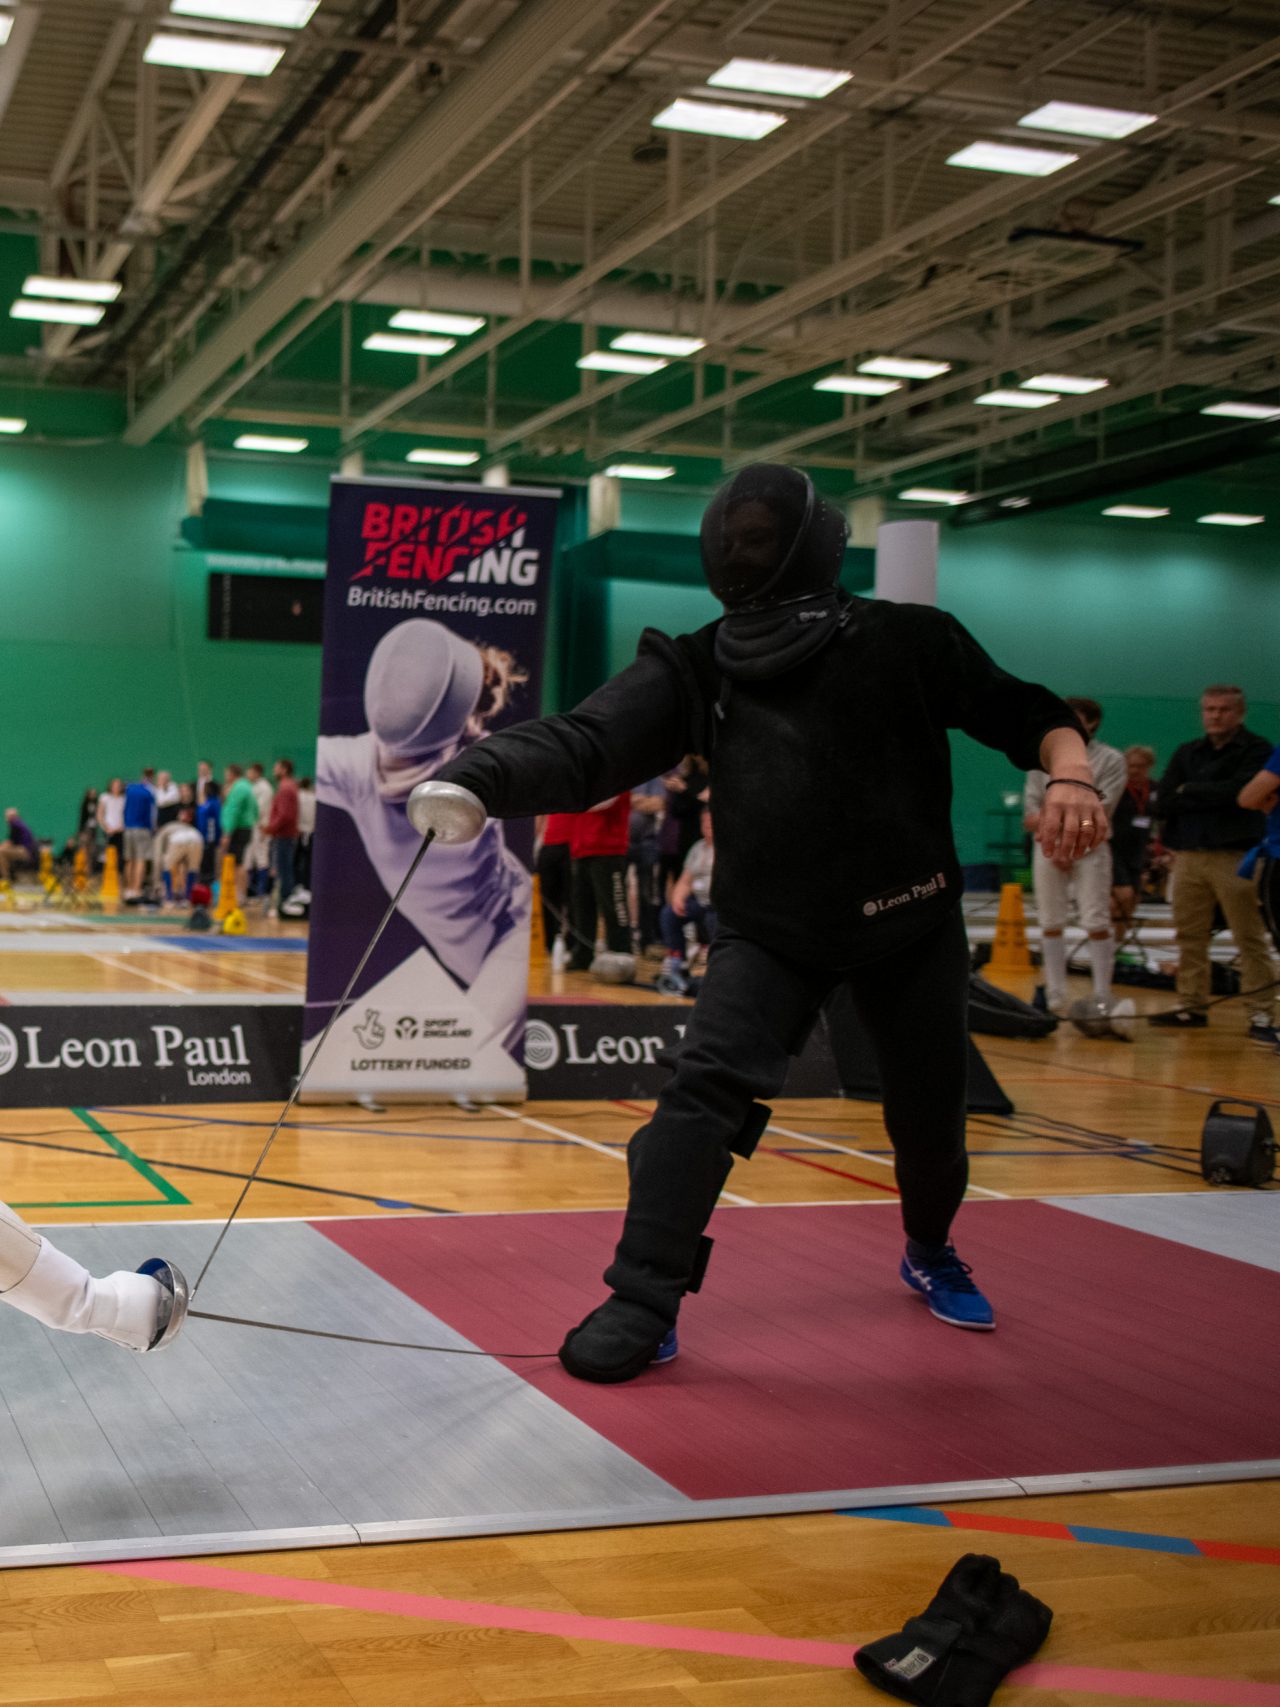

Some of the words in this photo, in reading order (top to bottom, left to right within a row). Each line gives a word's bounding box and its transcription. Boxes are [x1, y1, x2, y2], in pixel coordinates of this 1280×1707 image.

[361, 501, 528, 548] BRITISH
[350, 541, 540, 586] FENCING
[347, 585, 538, 617] BritishFencing.com
[877, 892, 911, 912] Leon
[911, 877, 938, 899] Paul
[423, 1017, 459, 1028] SPORT
[423, 1028, 473, 1038] ENGLAND
[22, 1026, 142, 1069] Leon
[150, 1024, 251, 1067] Paul
[186, 1067, 252, 1087] London
[350, 1058, 413, 1071] LOTTERY
[415, 1057, 472, 1071] FUNDED
